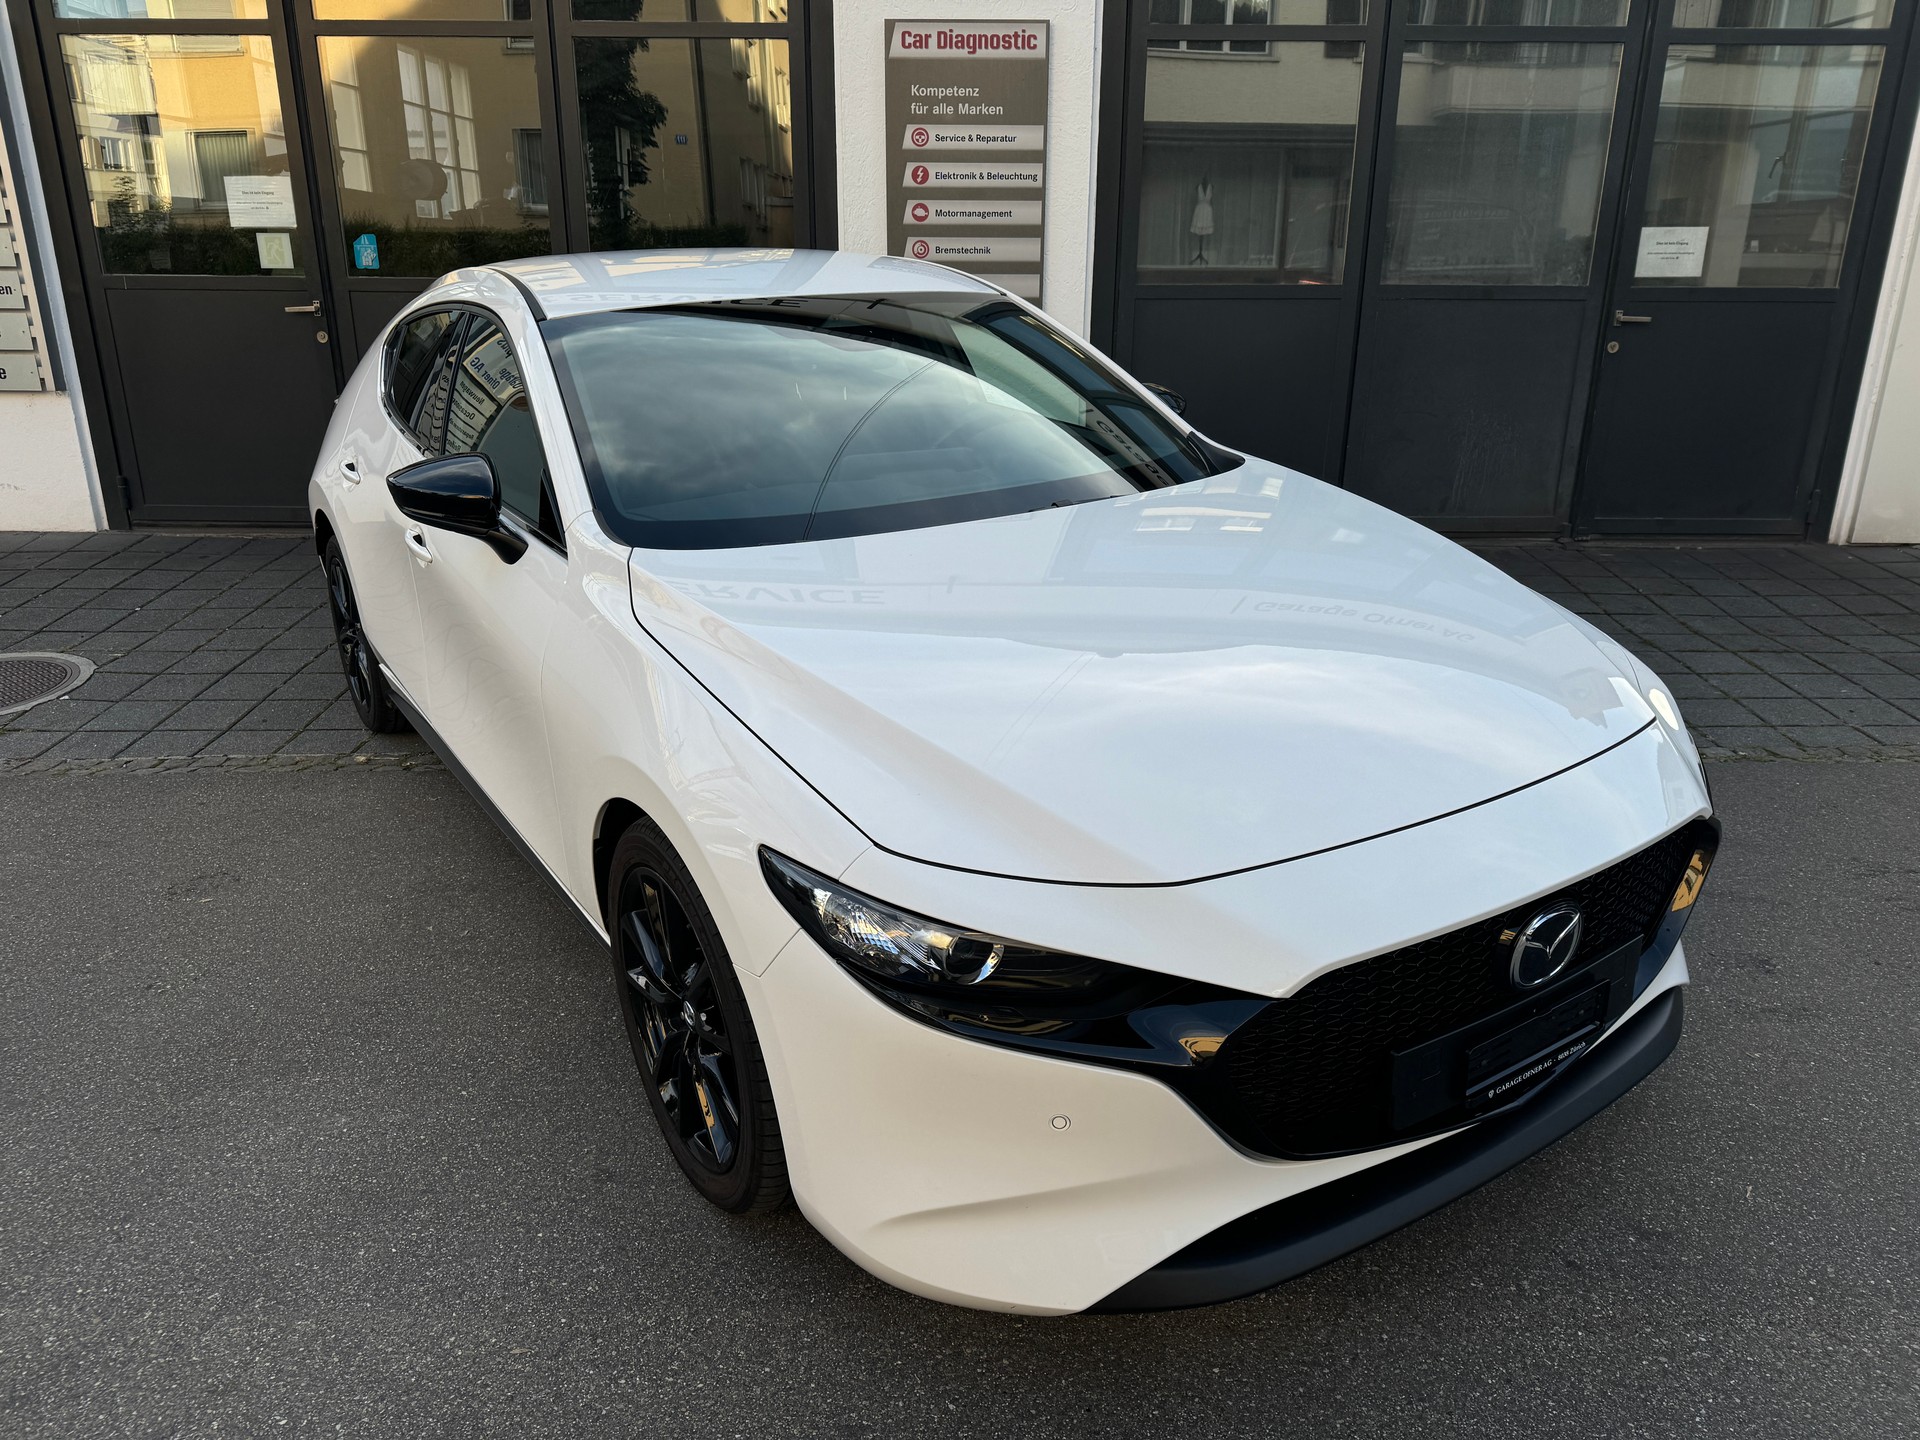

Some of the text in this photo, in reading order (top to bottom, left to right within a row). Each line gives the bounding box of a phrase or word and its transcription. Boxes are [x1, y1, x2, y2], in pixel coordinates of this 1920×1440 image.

[901, 28, 1038, 55] Car Diagnostic
[911, 84, 980, 99] Kompetenz
[910, 102, 1004, 115] für alle Marken
[934, 133, 1018, 144] Service & Reparatur
[934, 171, 1039, 183] Elektronik & Beleuchtung
[934, 209, 1013, 219] Motormanagement
[934, 245, 991, 255] Bremstechnik
[1496, 1075, 1523, 1094] GARAGE
[1522, 1064, 1543, 1080] OFNER
[1542, 1059, 1553, 1070] AG
